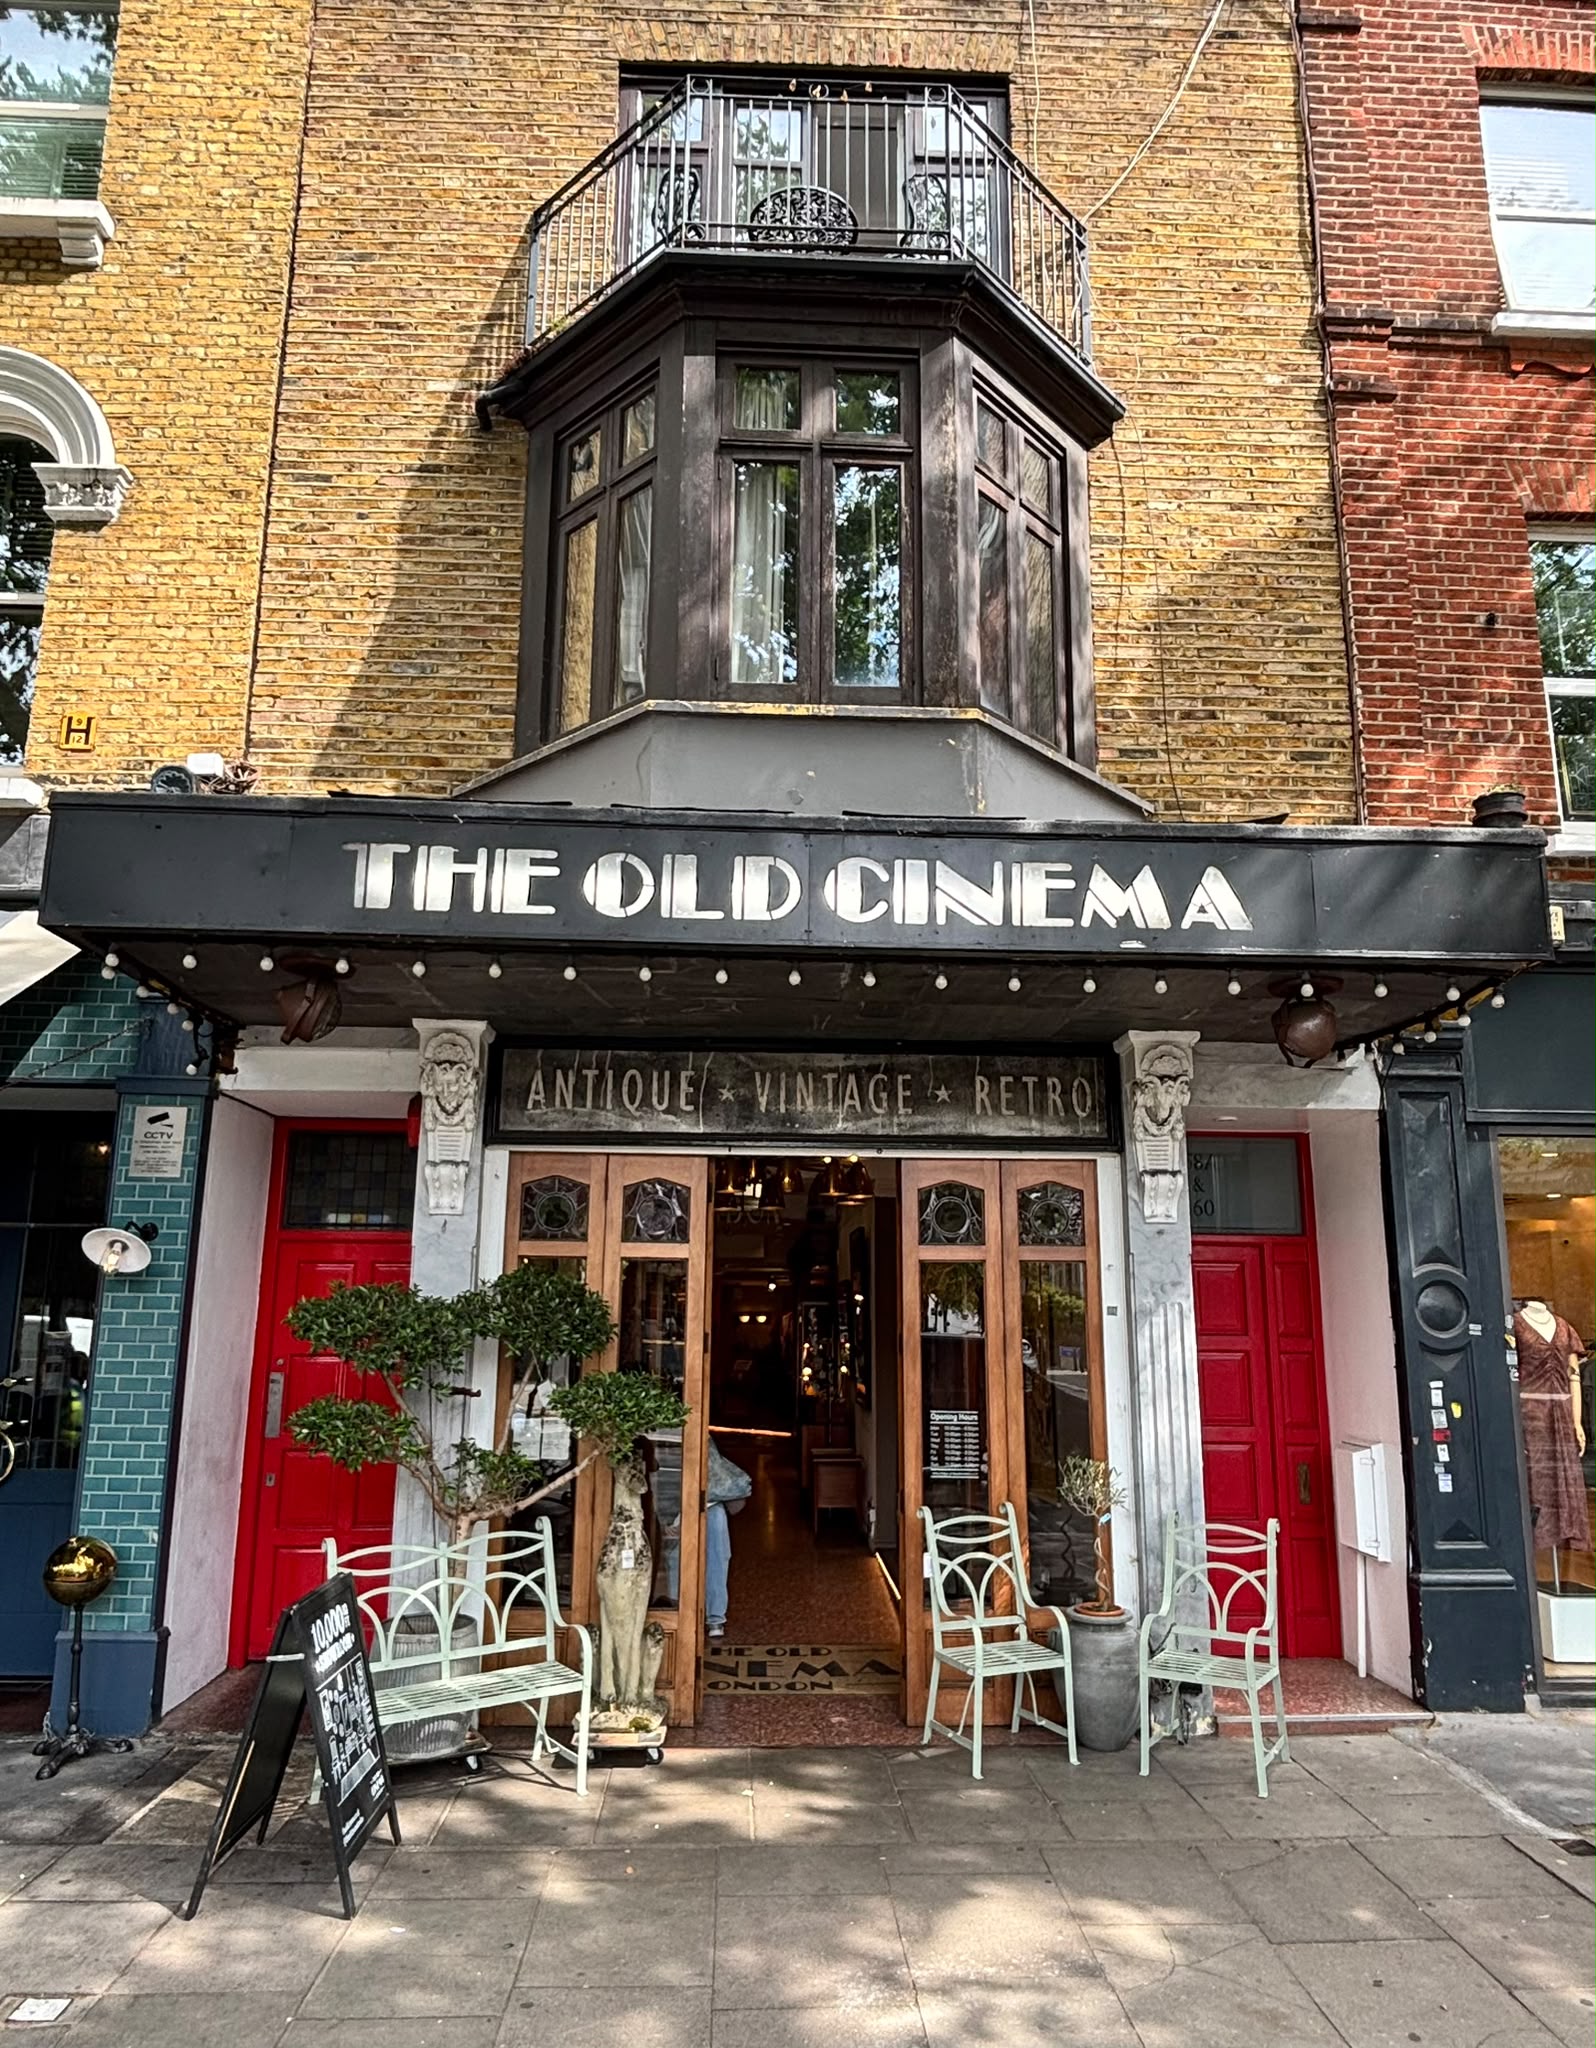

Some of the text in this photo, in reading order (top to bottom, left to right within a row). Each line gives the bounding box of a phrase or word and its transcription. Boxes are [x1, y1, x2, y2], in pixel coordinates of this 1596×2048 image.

[76, 718, 83, 726] 9
[64, 716, 92, 745] H
[72, 735, 83, 743] 12
[342, 843, 1254, 931] THE OLD CINEMA
[526, 1068, 1092, 1118] ANTIQUE VINTAGE RETRO
[144, 1131, 174, 1139] CCTV
[958, 1413, 978, 1421] Hours
[311, 1604, 345, 1654] 10,000
[710, 1646, 833, 1657] HE OLD
[704, 1658, 901, 1679] NEMA
[704, 1680, 834, 1691] ONDON
